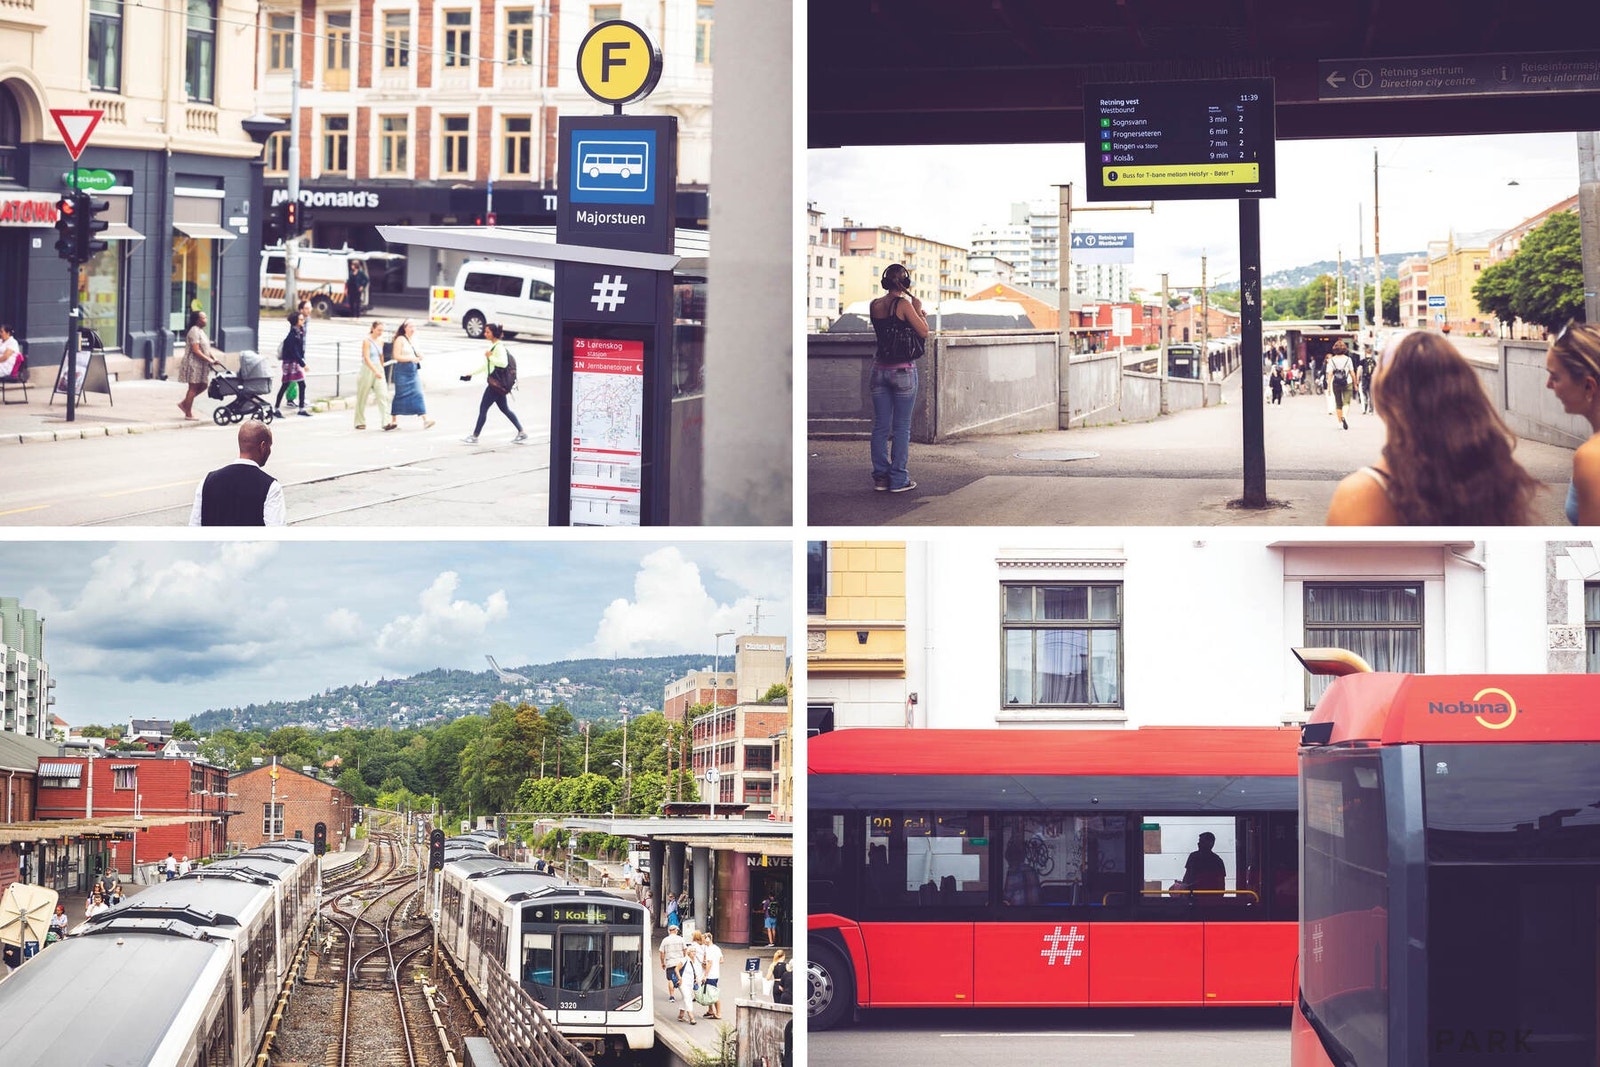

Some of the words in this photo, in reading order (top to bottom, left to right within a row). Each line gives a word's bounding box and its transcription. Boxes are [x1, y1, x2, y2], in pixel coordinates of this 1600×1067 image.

[601, 42, 630, 82] F
[1521, 61, 1600, 72] Reiseinformasj
[1380, 68, 1418, 78] Retning
[1420, 66, 1464, 76] sentrum
[1380, 79, 1423, 88] Direction
[1426, 79, 1442, 88] city
[1444, 78, 1476, 86] centre
[1522, 74, 1552, 83] Travel
[1100, 98, 1125, 106] Retning
[1112, 119, 1148, 127] Sognsvann
[1112, 130, 1162, 139] Frognerseteren
[1114, 154, 1134, 162] Kolsås
[70, 176, 108, 184] Secsavers
[271, 190, 380, 208] MDonald's
[576, 210, 645, 226] Majorstuen
[587, 341, 623, 351] Lørenskog
[587, 363, 632, 372] Jernbanetorget
[1428, 701, 1508, 714] Nobina
[554, 911, 560, 919] 3
[749, 962, 756, 970] 3
